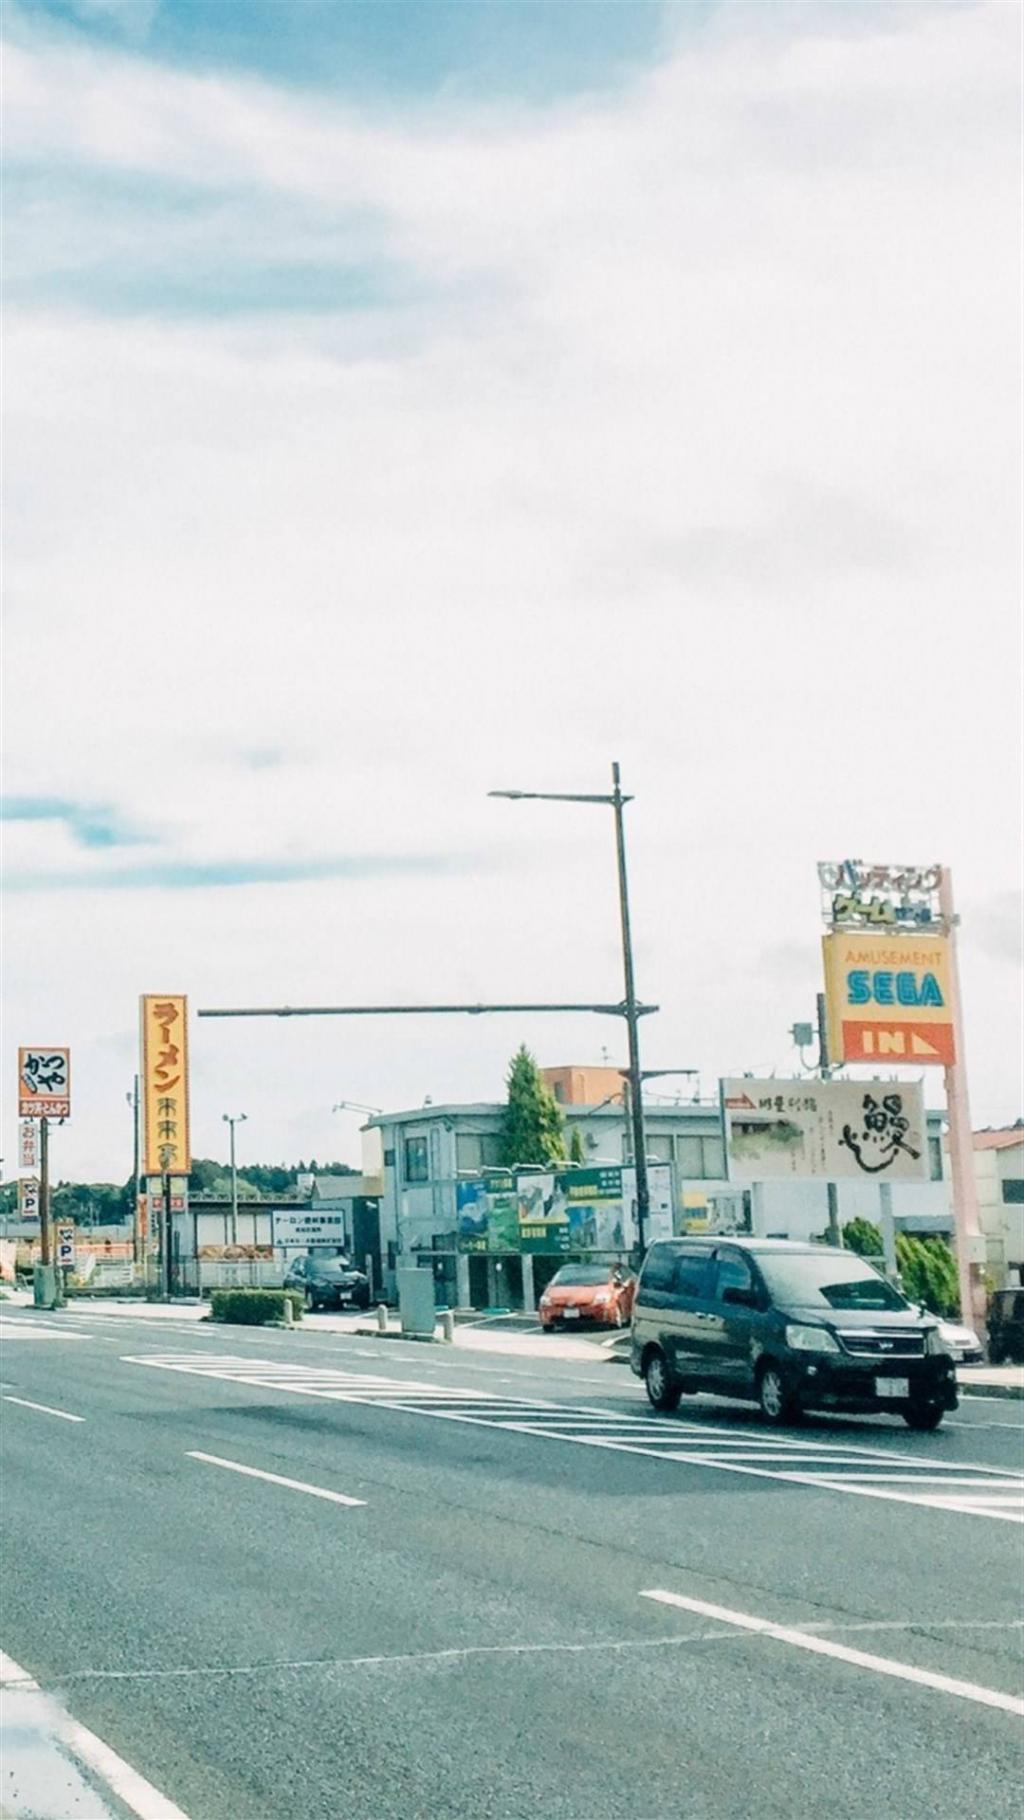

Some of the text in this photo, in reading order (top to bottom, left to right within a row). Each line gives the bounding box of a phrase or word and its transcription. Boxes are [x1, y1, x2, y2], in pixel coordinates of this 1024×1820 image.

[845, 950, 942, 966] AMUSEMENT
[847, 970, 945, 1007] SEGA
[153, 1003, 181, 1093] ラーメン
[862, 1030, 906, 1054] IN
[25, 1198, 35, 1209] P
[60, 1245, 72, 1257] P
